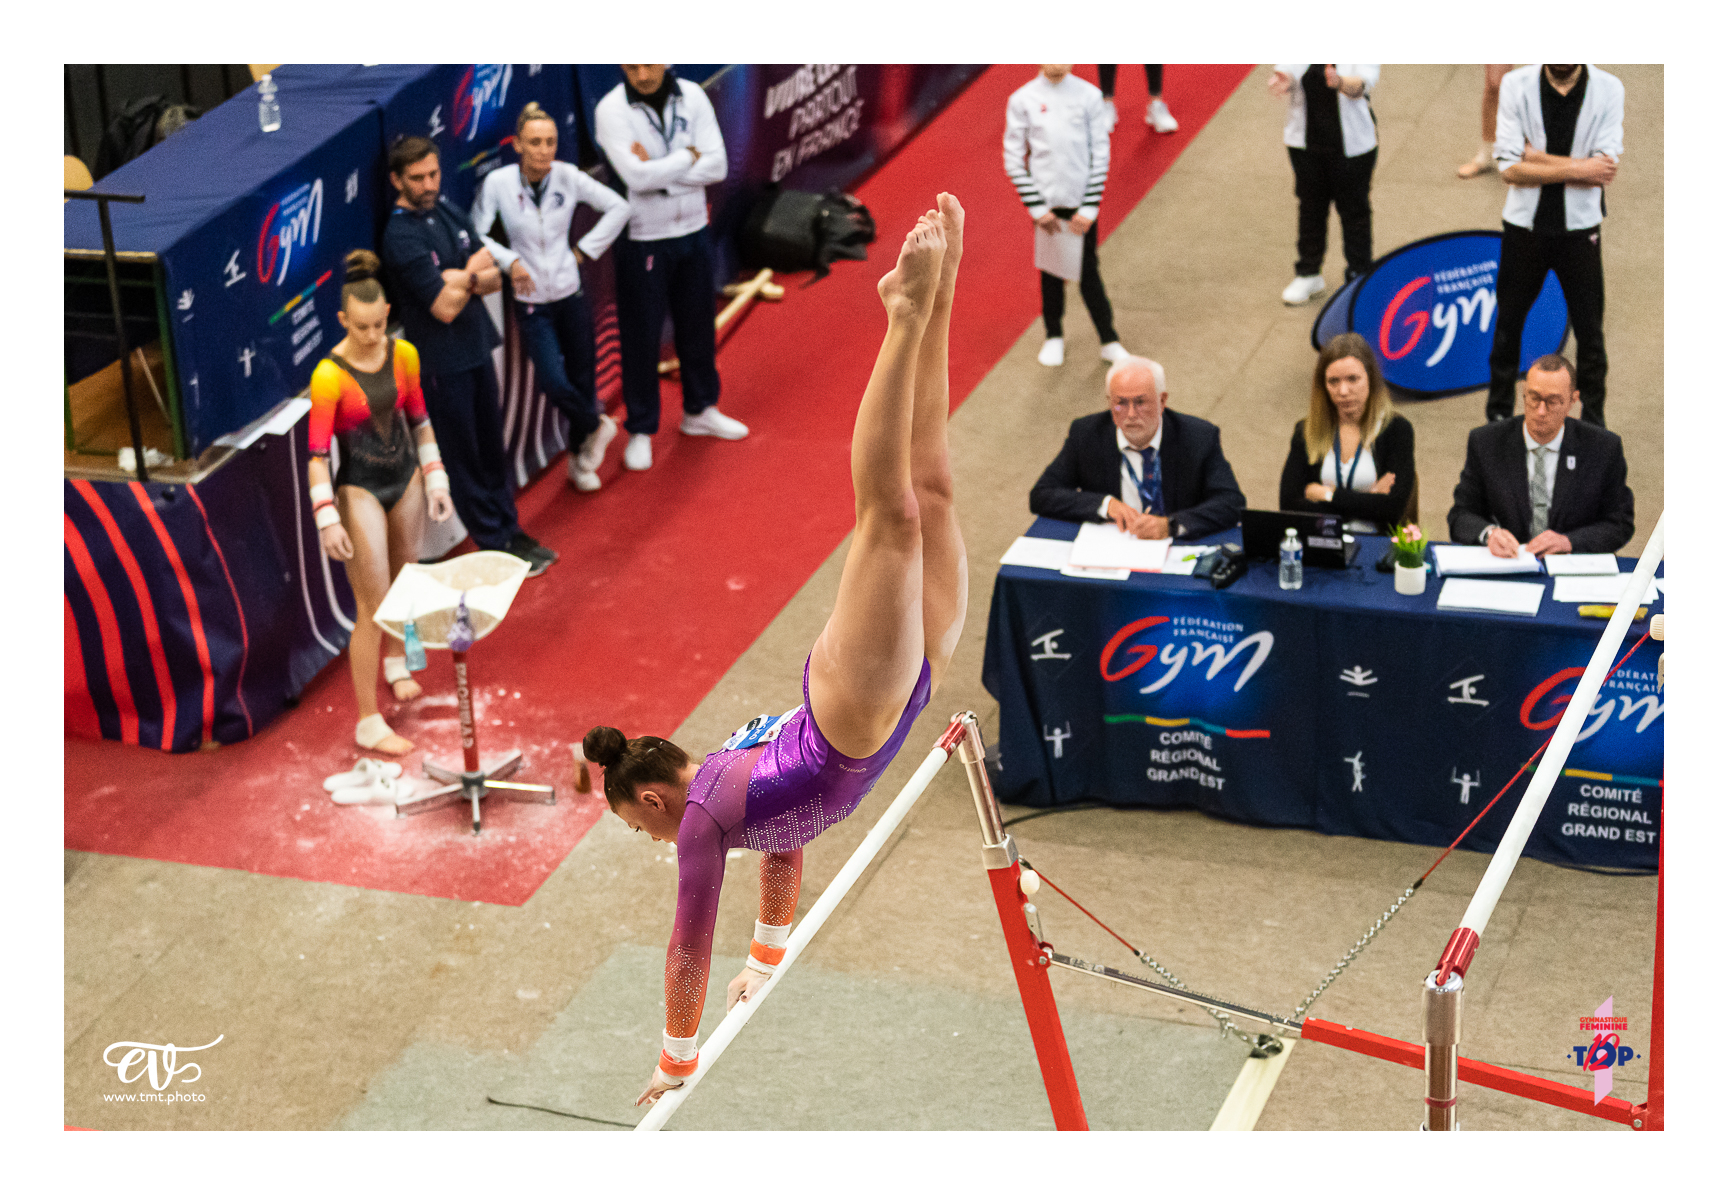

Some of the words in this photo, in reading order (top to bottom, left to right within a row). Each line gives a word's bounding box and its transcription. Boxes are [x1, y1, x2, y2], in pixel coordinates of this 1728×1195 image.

[788, 64, 857, 140] PARTOUT
[771, 143, 798, 182] EN
[795, 99, 865, 167] FRANCE
[257, 178, 323, 286] Gym
[1173, 616, 1244, 632] FÉDÉRATION
[1173, 628, 1234, 643] FRANÇAISE
[1099, 615, 1275, 694] Gym
[1159, 730, 1212, 750] COMITÉ
[1150, 748, 1222, 772] RÉGIONAL
[1146, 766, 1200, 782] GRAND
[1199, 772, 1226, 791] EST
[1579, 784, 1642, 804] COMITÉ
[1567, 801, 1653, 825] RÉGIONAL
[1561, 822, 1621, 841] GRAND
[1624, 828, 1657, 845] EST
